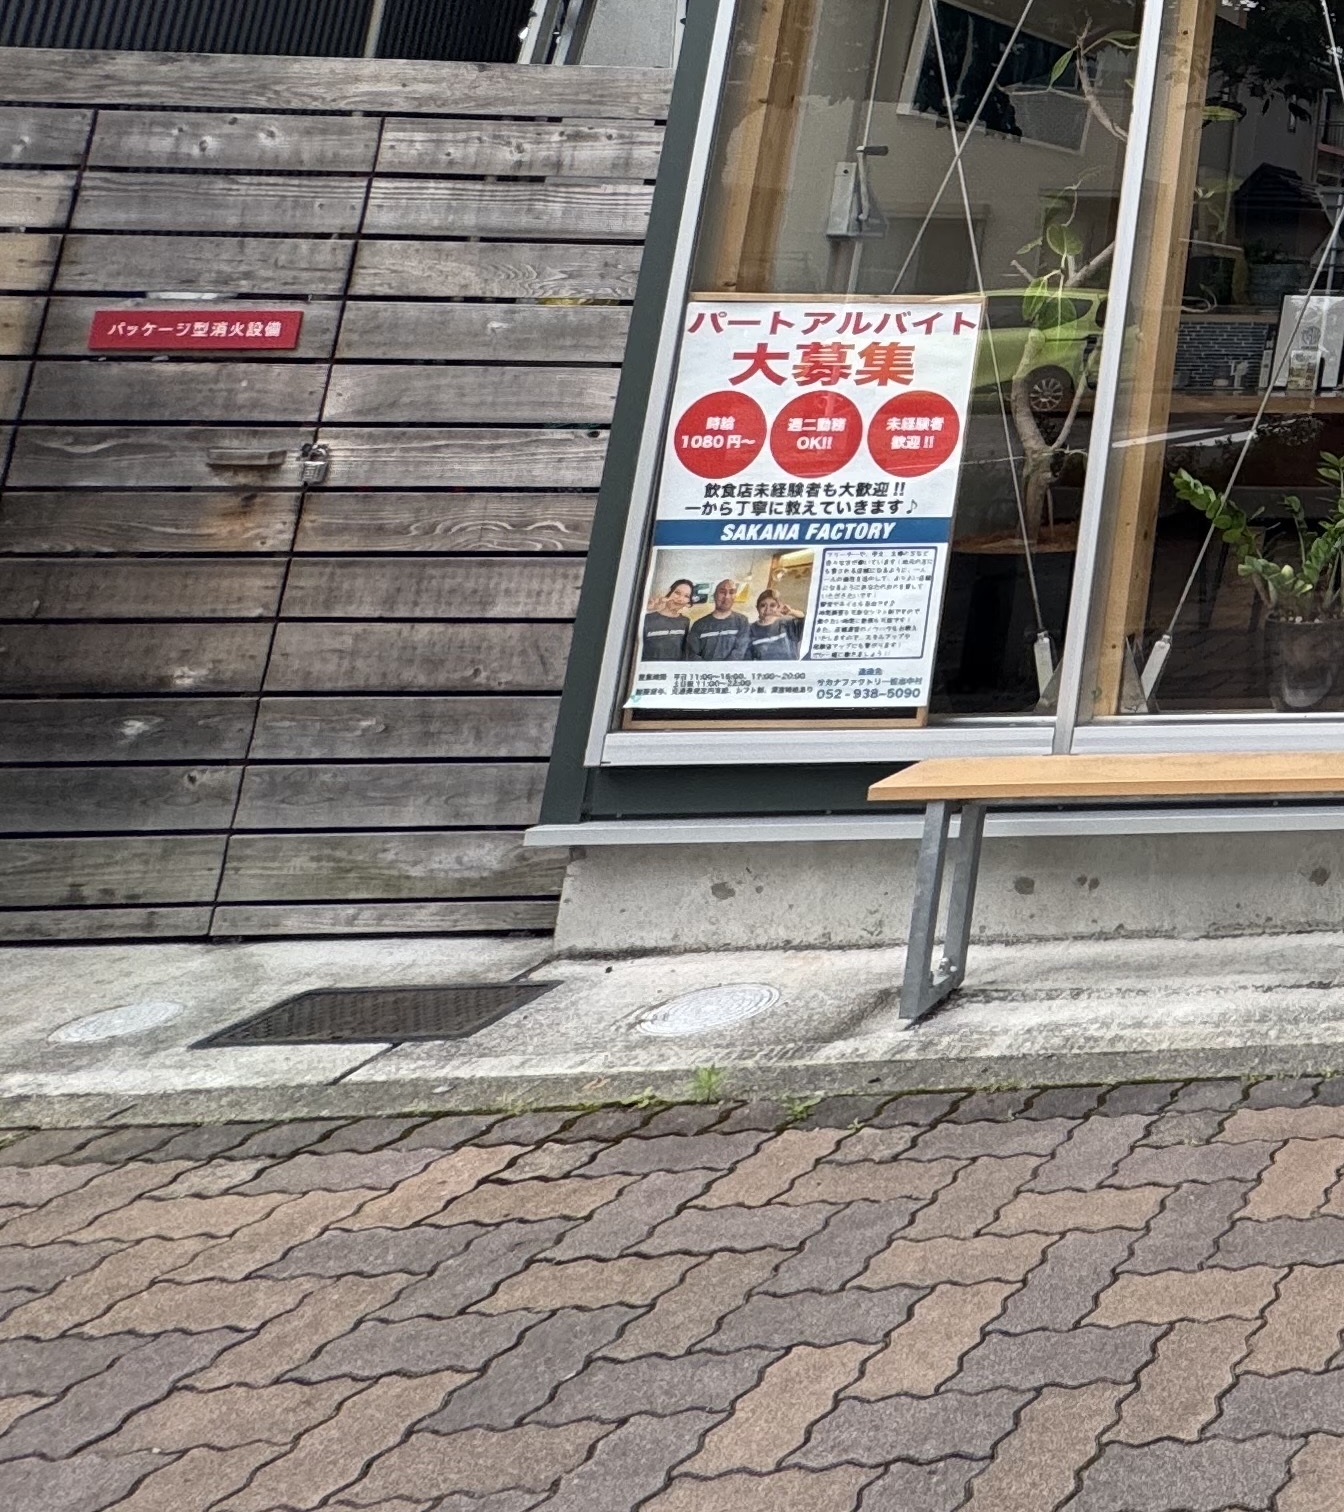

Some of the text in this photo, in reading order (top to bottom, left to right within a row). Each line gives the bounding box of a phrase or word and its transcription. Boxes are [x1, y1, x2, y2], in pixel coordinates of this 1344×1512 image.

[106, 320, 283, 338] パッケージ型消火設備
[687, 310, 978, 336] パートアルバイト
[727, 340, 917, 387] 大募集
[720, 521, 897, 542] SAKANA FACTORY
